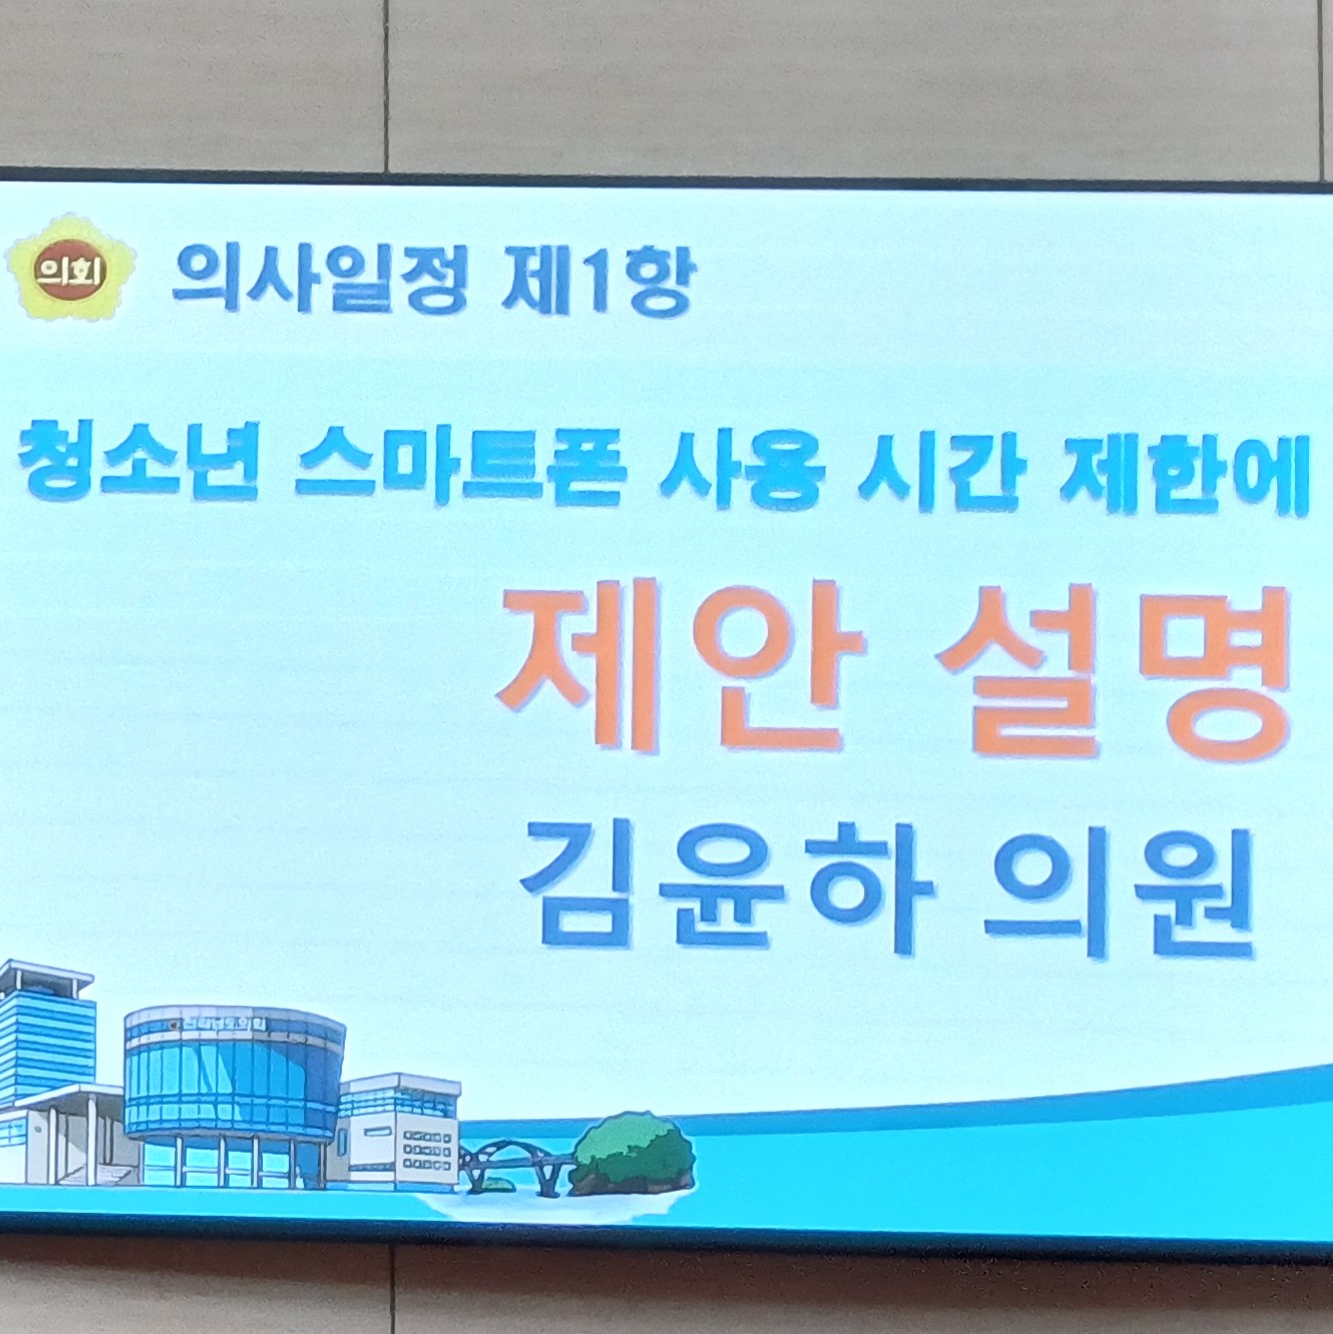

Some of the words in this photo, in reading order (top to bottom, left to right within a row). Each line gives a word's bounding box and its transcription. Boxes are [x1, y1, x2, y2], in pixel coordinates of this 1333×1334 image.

[36, 256, 101, 286] 의회
[171, 241, 470, 317] 의사일정
[500, 244, 699, 320] 제1항
[17, 418, 261, 503] 청소년
[293, 422, 629, 508] 스마트폰
[657, 426, 827, 513] 사용
[857, 428, 1030, 515] 시간
[1059, 431, 1312, 520] 제한에
[497, 578, 864, 752] 제안
[937, 583, 1291, 761] 설명
[518, 816, 938, 959] 김윤하
[982, 824, 1257, 963] 의원
